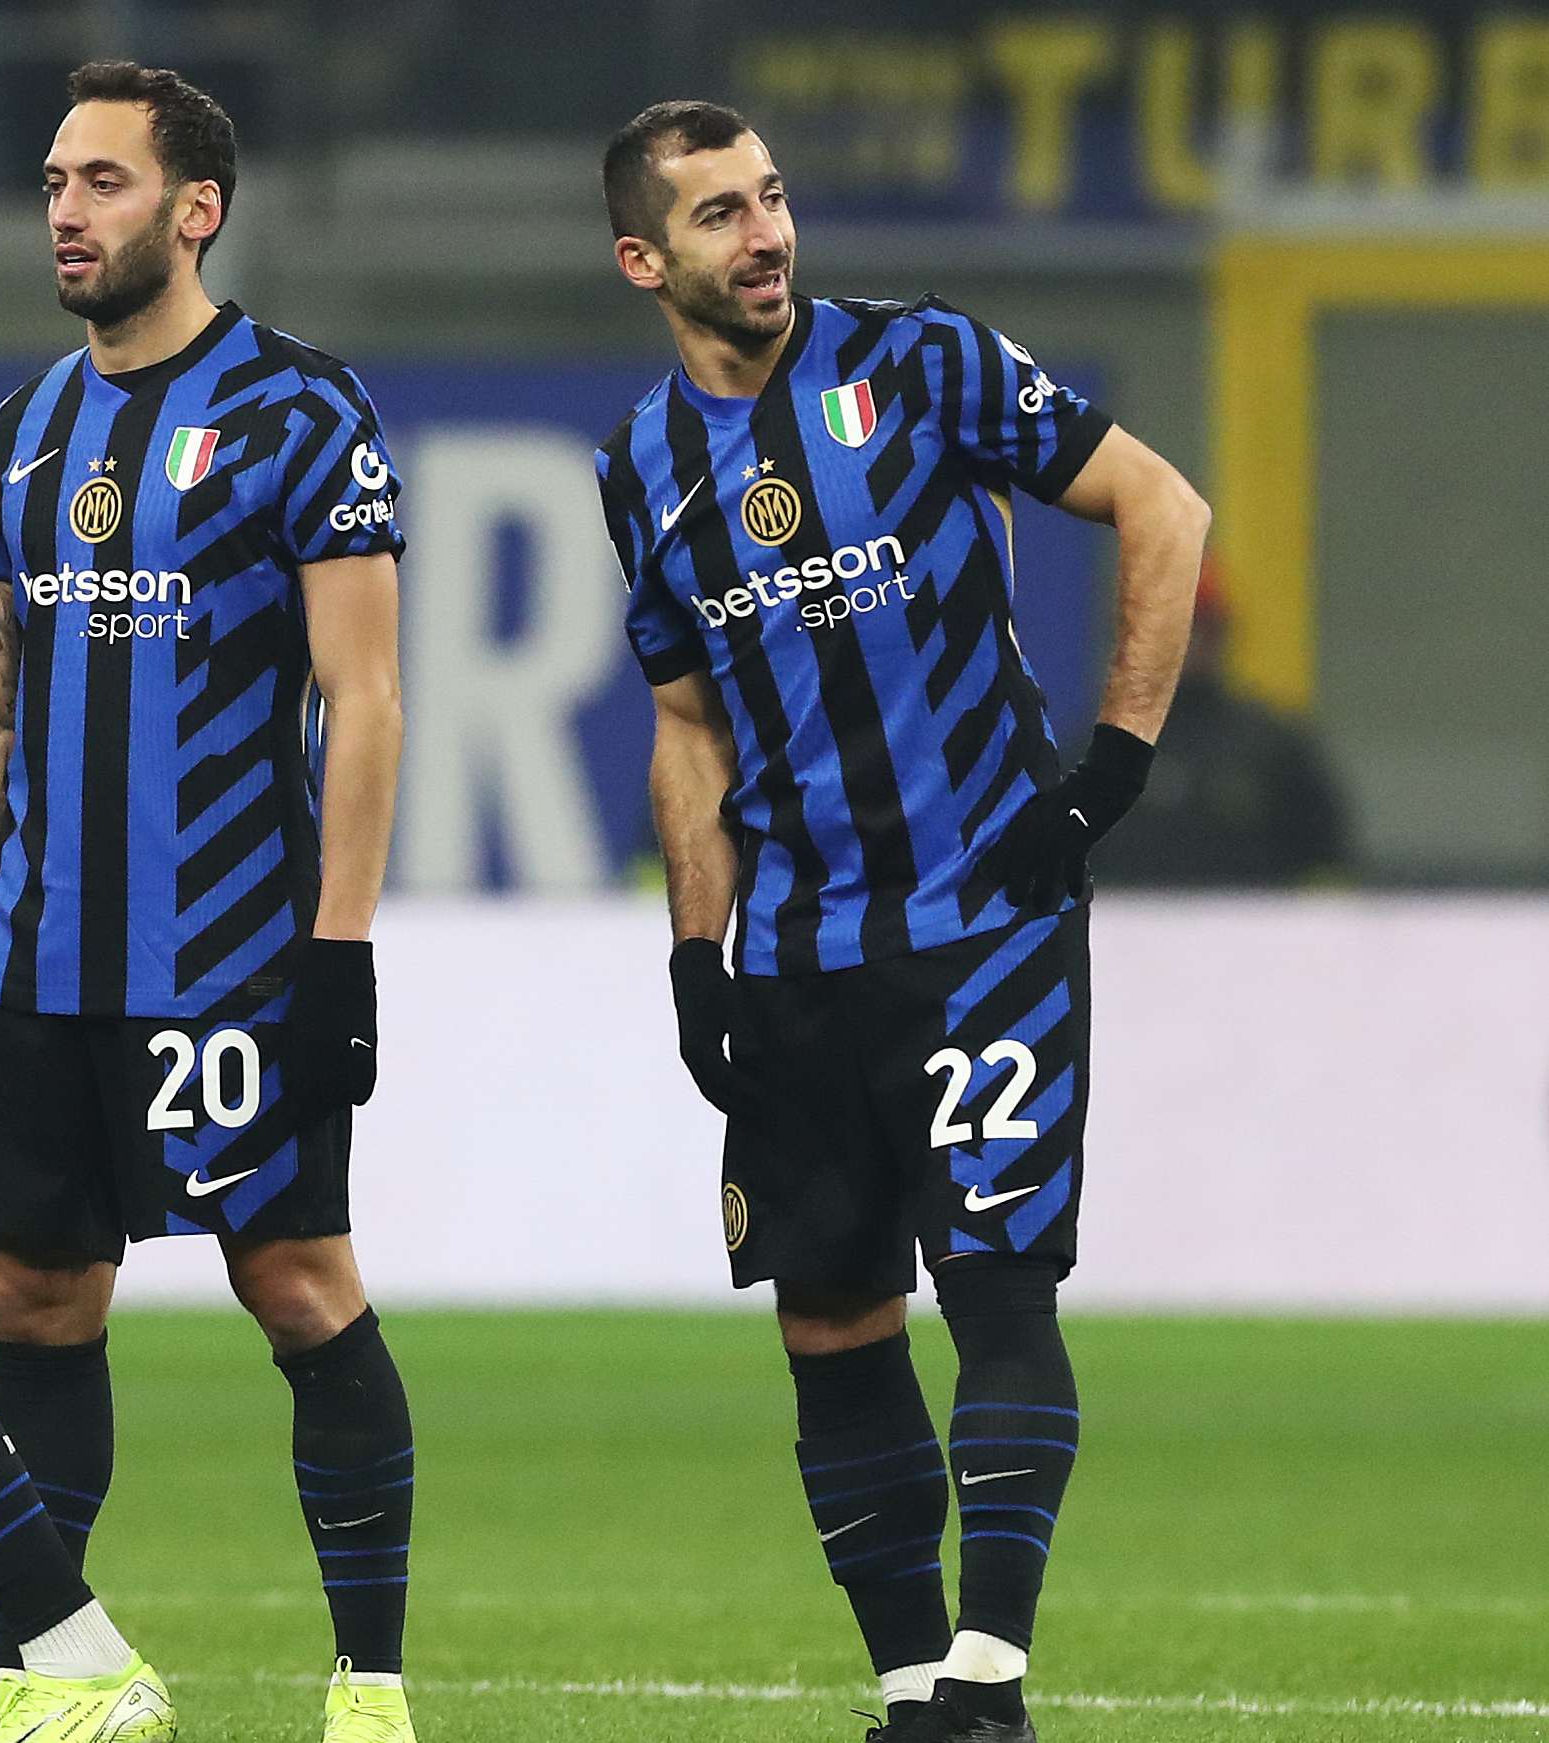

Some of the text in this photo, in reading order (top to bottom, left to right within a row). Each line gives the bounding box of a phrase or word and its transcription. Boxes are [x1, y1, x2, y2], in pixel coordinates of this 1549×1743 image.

[78, 608, 191, 645] .sport
[690, 535, 907, 629] betsson
[795, 571, 916, 632] .sport
[147, 1028, 261, 1131] 20
[922, 1038, 1042, 1149] 22
